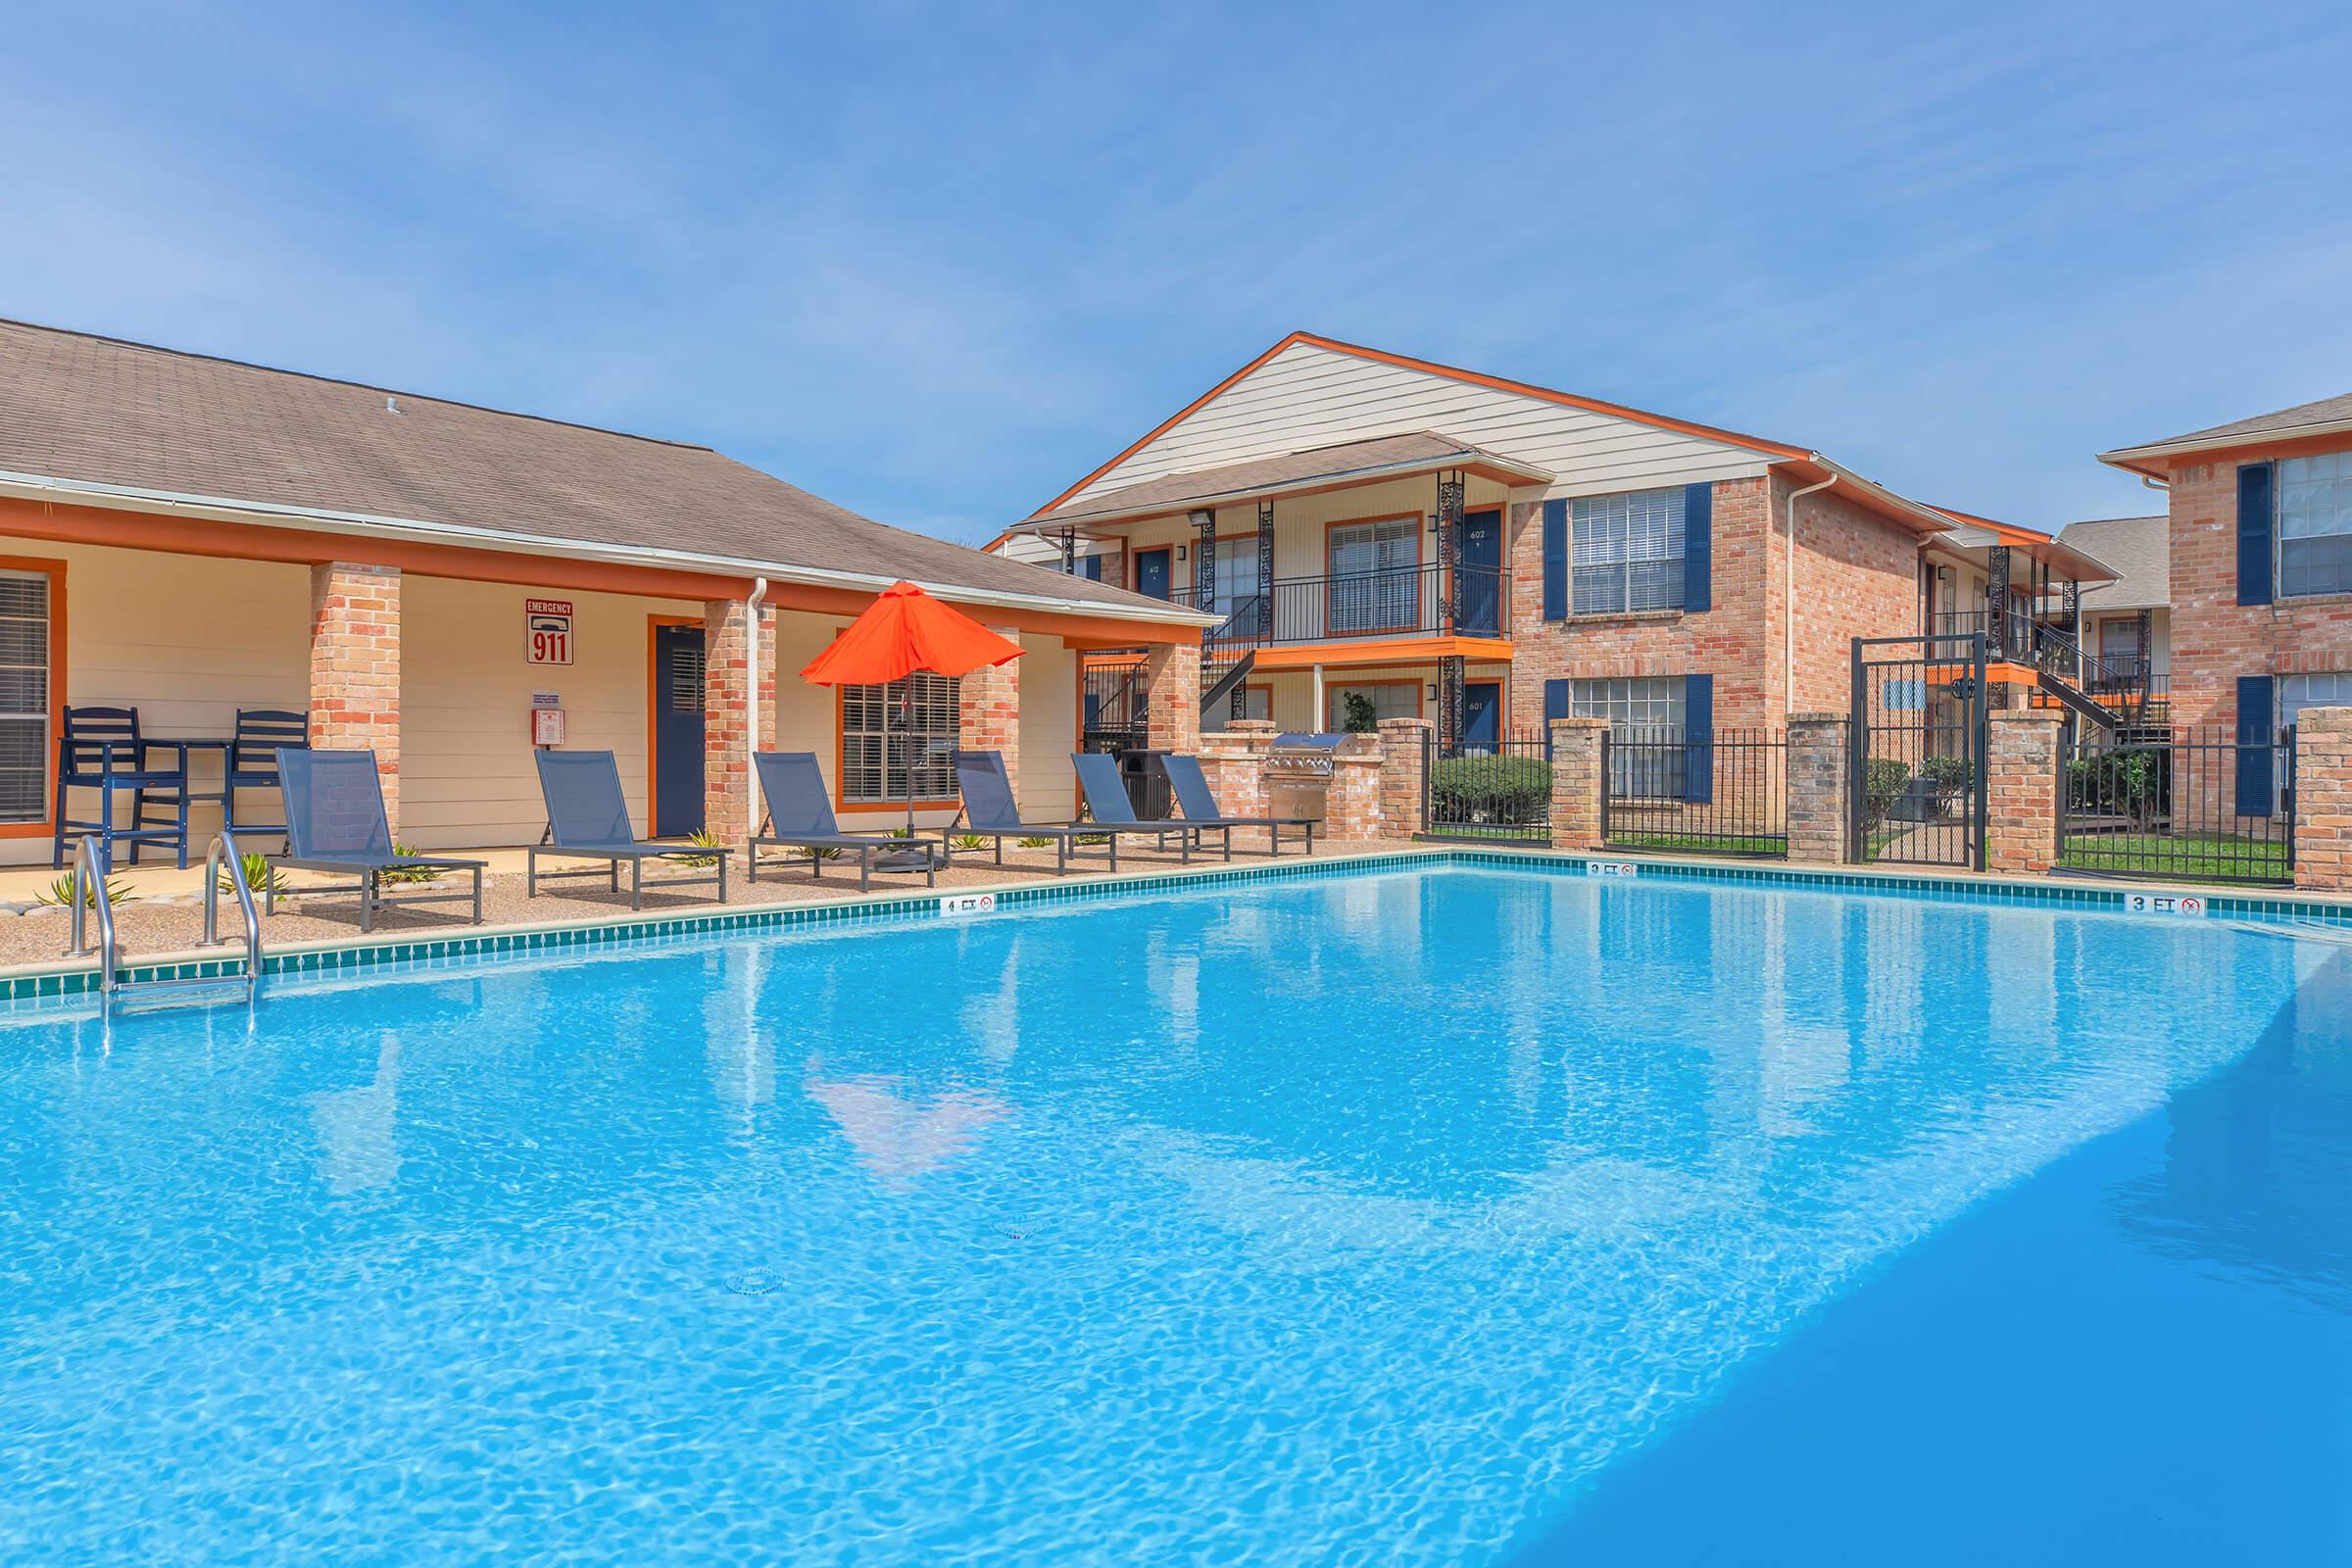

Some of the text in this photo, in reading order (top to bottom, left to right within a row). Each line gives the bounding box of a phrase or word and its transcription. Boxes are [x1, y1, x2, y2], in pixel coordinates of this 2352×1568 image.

[1470, 530, 1486, 539] 602
[527, 601, 571, 613] EMERGENCY
[533, 632, 565, 662] 911
[1469, 702, 1483, 710] 601
[2133, 896, 2145, 911] 3
